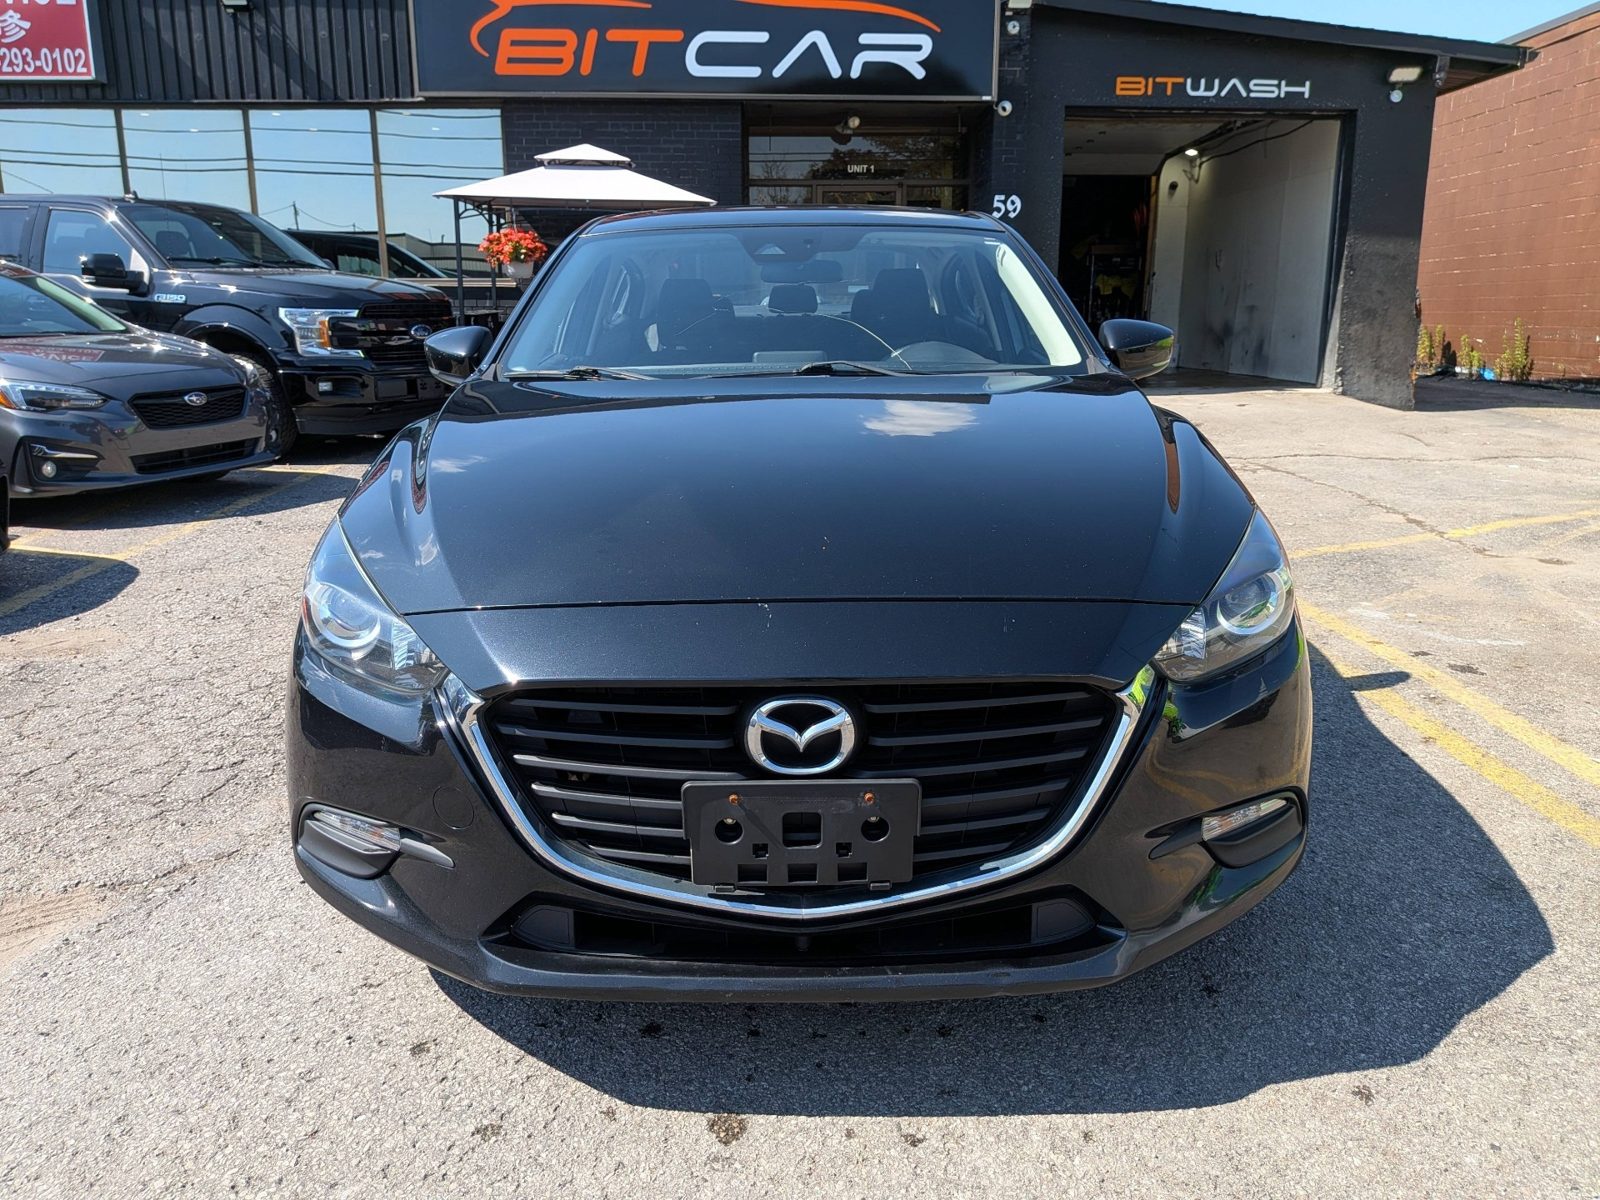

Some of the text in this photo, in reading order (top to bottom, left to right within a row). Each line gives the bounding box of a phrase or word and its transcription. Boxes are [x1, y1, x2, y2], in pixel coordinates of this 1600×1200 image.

[0, 47, 88, 73] 293-0102
[494, 28, 934, 80] BITCAR
[1115, 76, 1311, 99] BITWASH
[847, 164, 875, 173] UNIT 1
[991, 194, 1022, 219] 59
